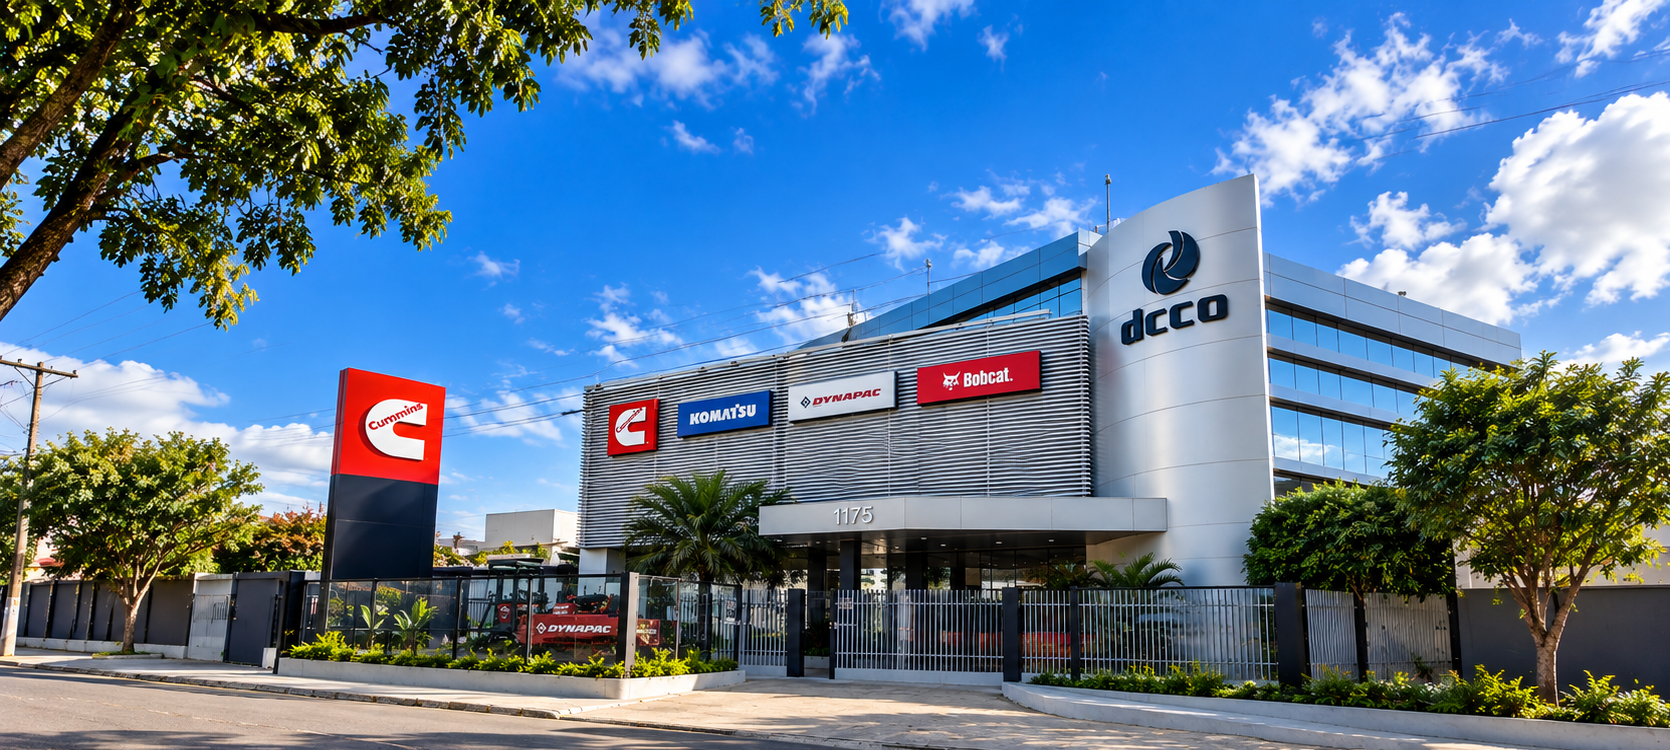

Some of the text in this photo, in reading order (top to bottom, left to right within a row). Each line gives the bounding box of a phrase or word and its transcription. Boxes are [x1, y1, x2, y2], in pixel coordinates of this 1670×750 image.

[1121, 294, 1228, 345] dcco
[812, 388, 881, 406] DYNAPAC
[368, 403, 424, 430] Cummins
[689, 403, 757, 425] KOMATSU
[833, 506, 874, 525] 1175
[547, 624, 611, 634] DYNAPAC
